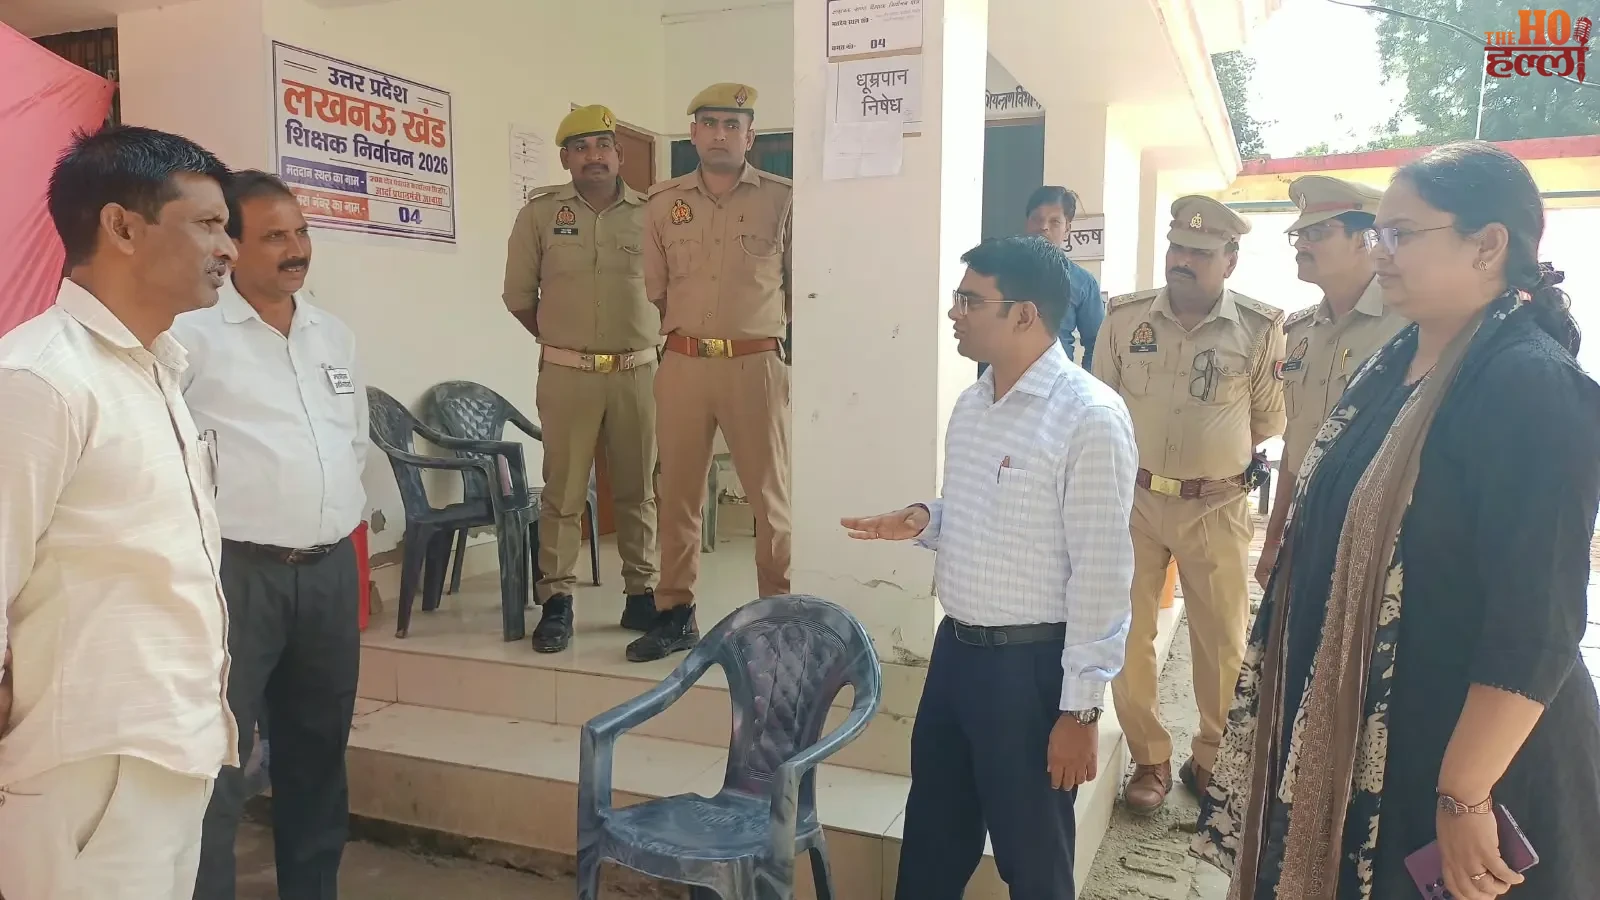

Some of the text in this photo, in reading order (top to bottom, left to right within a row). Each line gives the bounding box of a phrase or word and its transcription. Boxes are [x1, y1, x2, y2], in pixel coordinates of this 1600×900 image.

[870, 38, 886, 49] 04
[328, 66, 408, 104] उत्तर प्रदेश
[856, 69, 909, 94] धूम्रपान
[861, 93, 903, 117] निषेध
[1015, 84, 1041, 109] विभा
[282, 79, 447, 148] लखनऊ खंड
[285, 119, 448, 175] शिक्षक निर्वाचन 2026
[286, 164, 313, 179] मतदान
[314, 168, 332, 182] स्थल
[333, 171, 343, 185] का
[344, 174, 360, 187] नाम
[344, 201, 360, 214] नाम
[399, 206, 423, 224] 04
